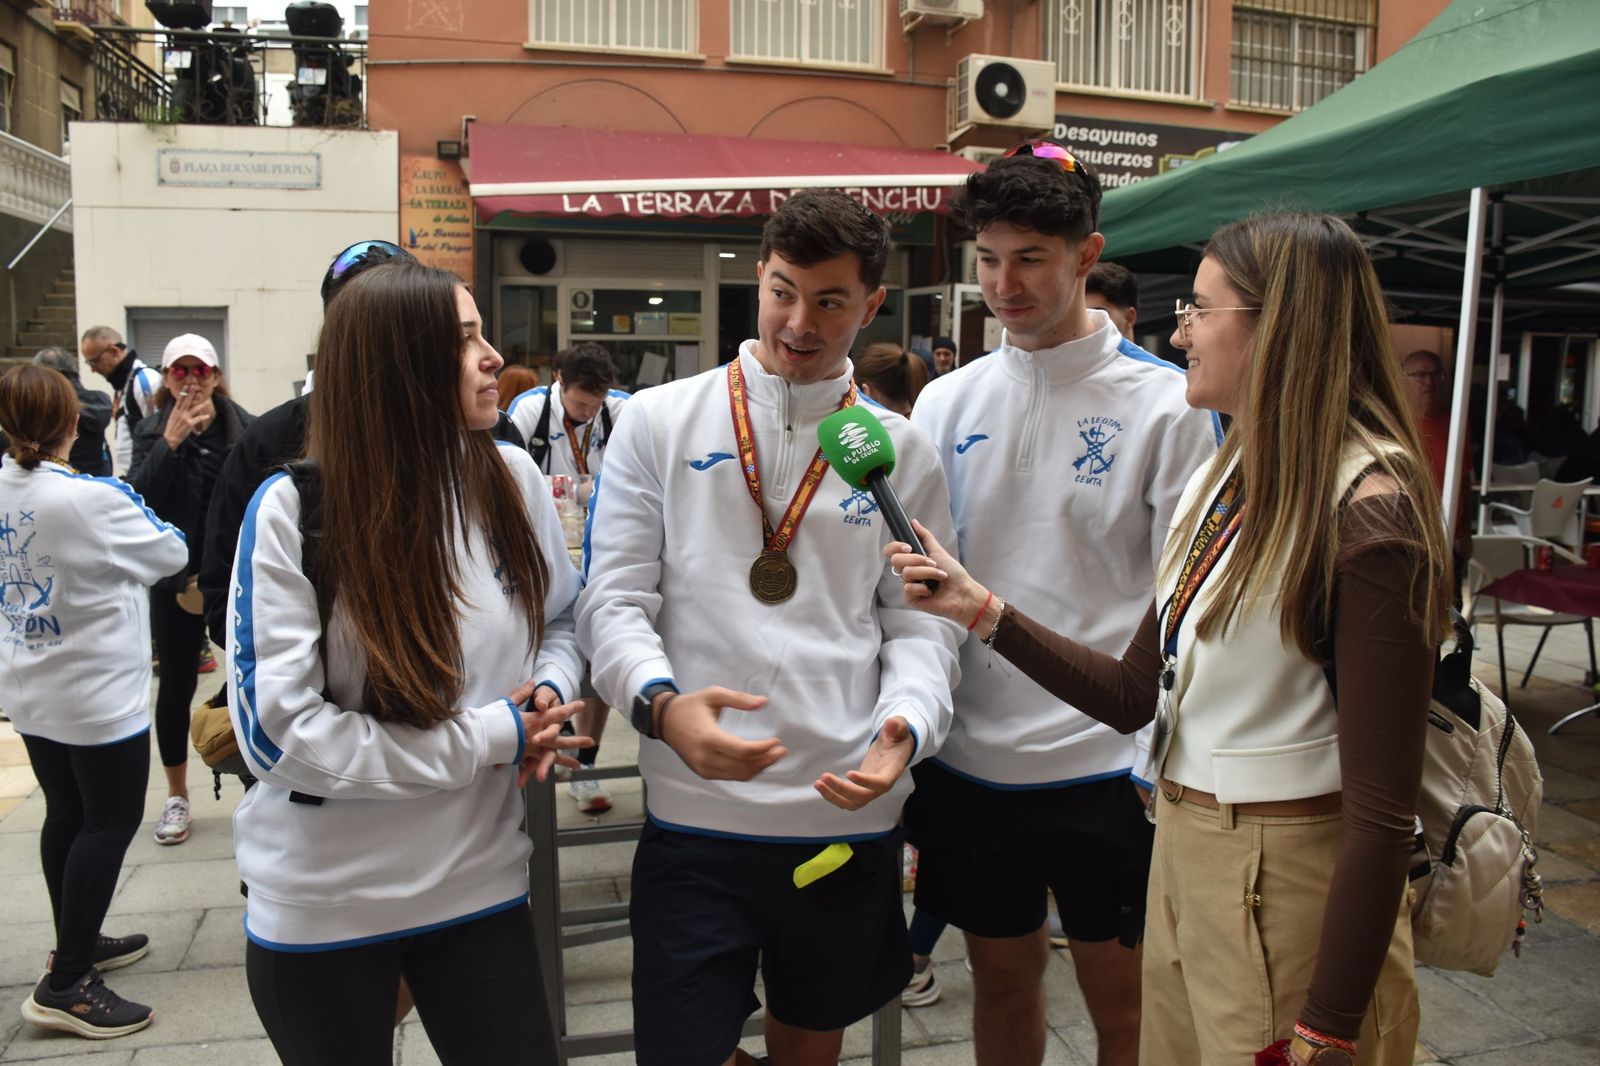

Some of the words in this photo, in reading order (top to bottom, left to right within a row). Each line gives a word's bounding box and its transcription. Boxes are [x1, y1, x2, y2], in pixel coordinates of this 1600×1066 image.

[1053, 122, 1159, 147] Desayunos
[1067, 145, 1154, 169] muerzos
[183, 161, 218, 174] PLAZA
[424, 199, 468, 210] TERRAZA
[562, 193, 602, 214] LA
[614, 190, 756, 214] TERRAZA
[828, 187, 942, 210] ENCHU
[843, 455, 853, 464] EL
[851, 440, 881, 458] PUEBLO
[851, 457, 860, 465] DE
[860, 447, 879, 459] CEUTA
[1074, 474, 1103, 487] CEUTA
[843, 515, 872, 527] CEUTA
